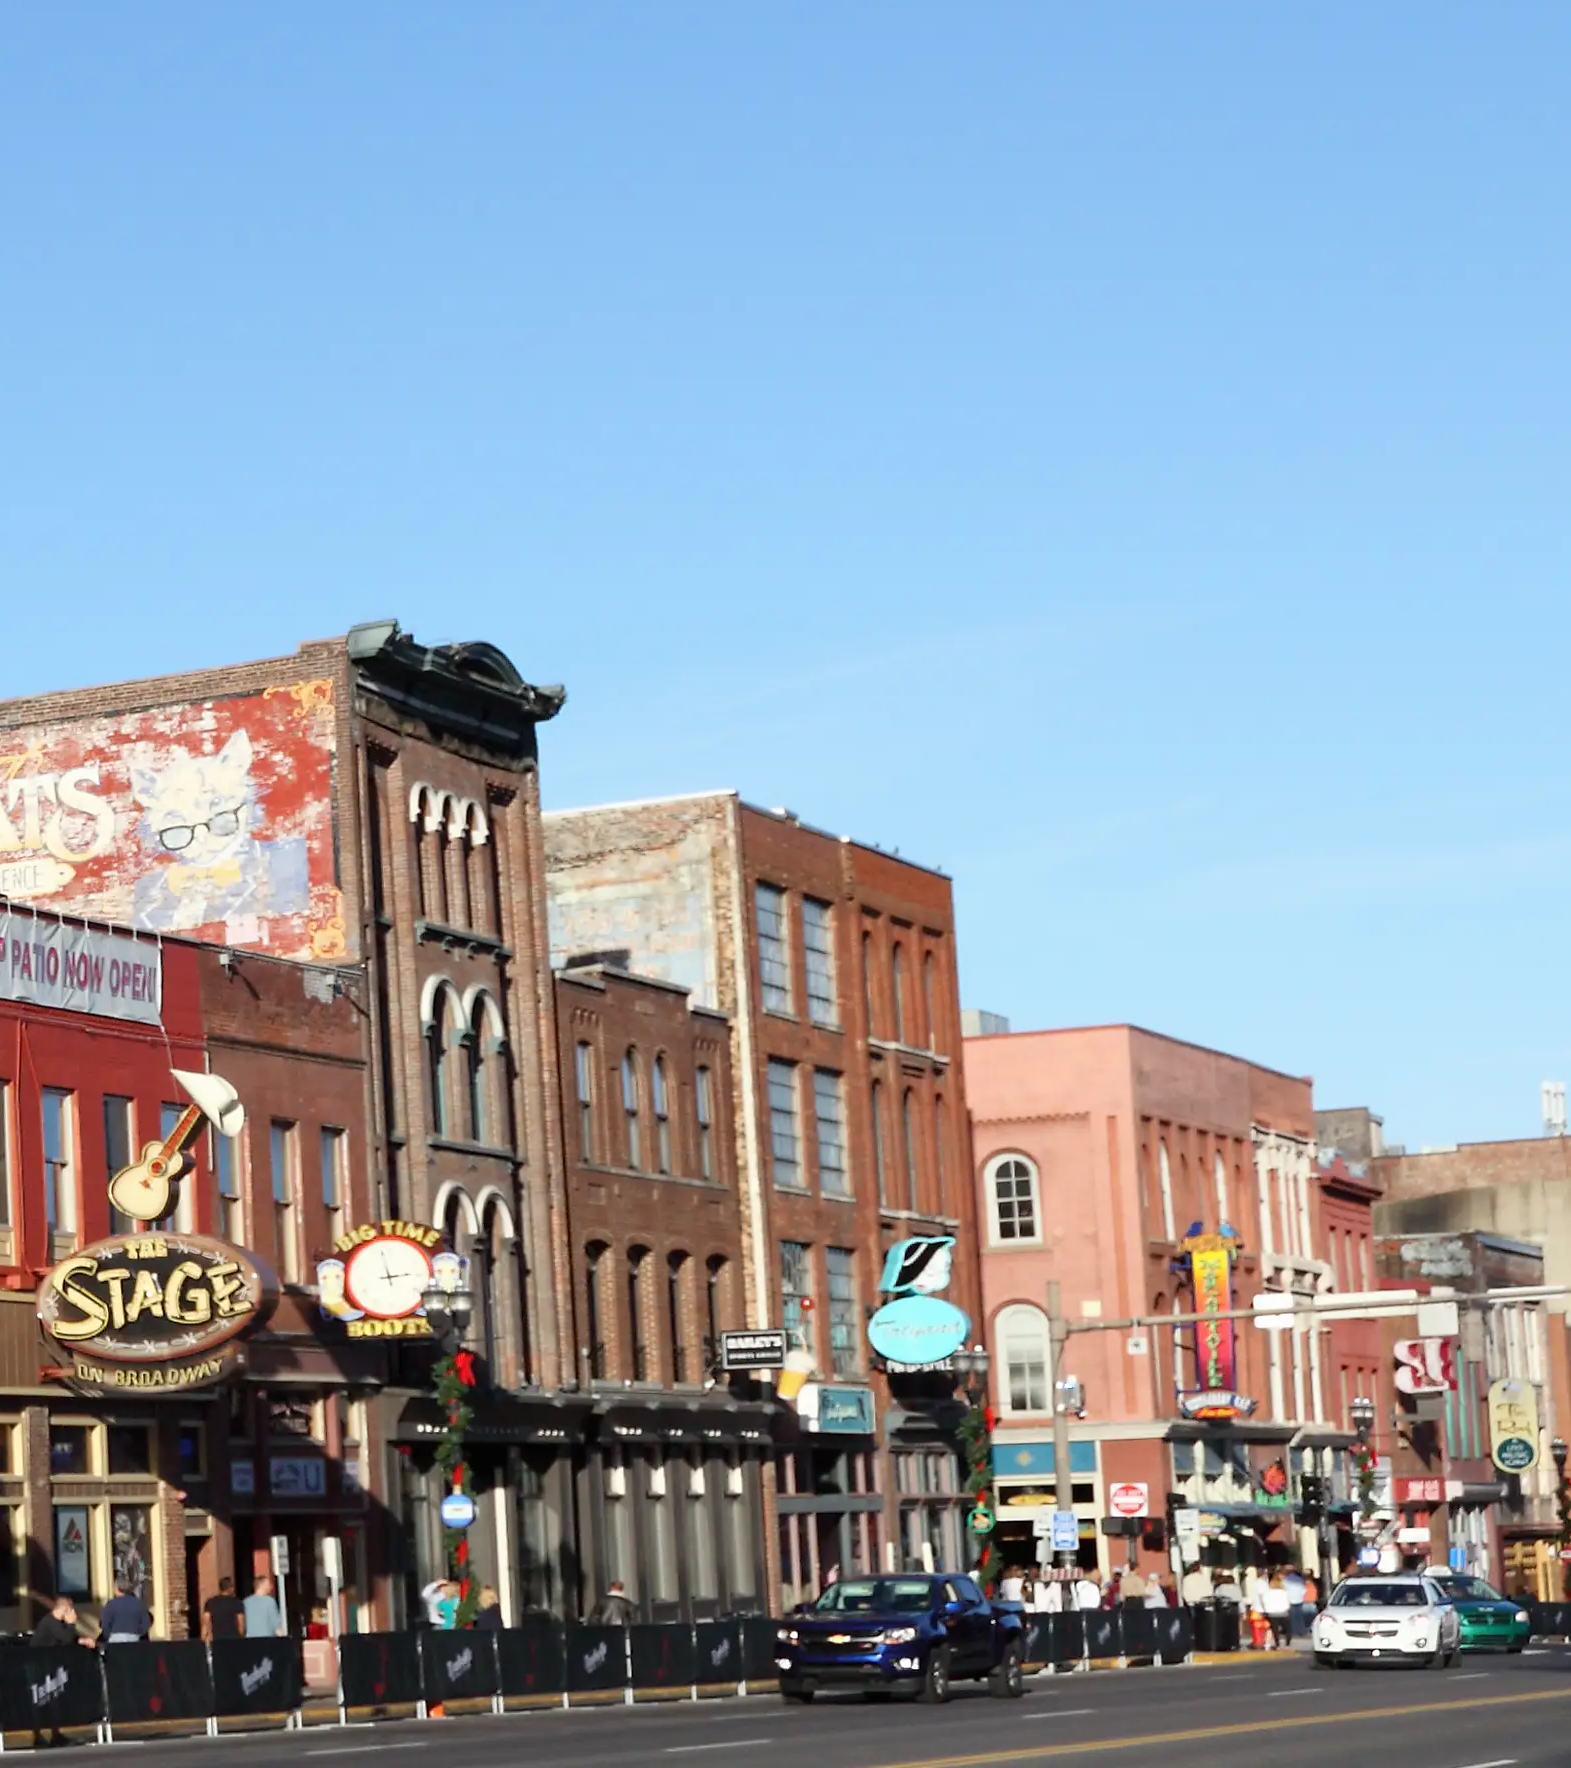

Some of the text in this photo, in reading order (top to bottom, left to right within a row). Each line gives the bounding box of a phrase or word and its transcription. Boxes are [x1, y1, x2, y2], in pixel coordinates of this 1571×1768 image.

[64, 949, 105, 995] NOW
[124, 1237, 168, 1259] THE
[381, 1219, 441, 1248] TIME
[52, 1257, 253, 1341] STAGE
[77, 1358, 223, 1387] ON BROADWAY
